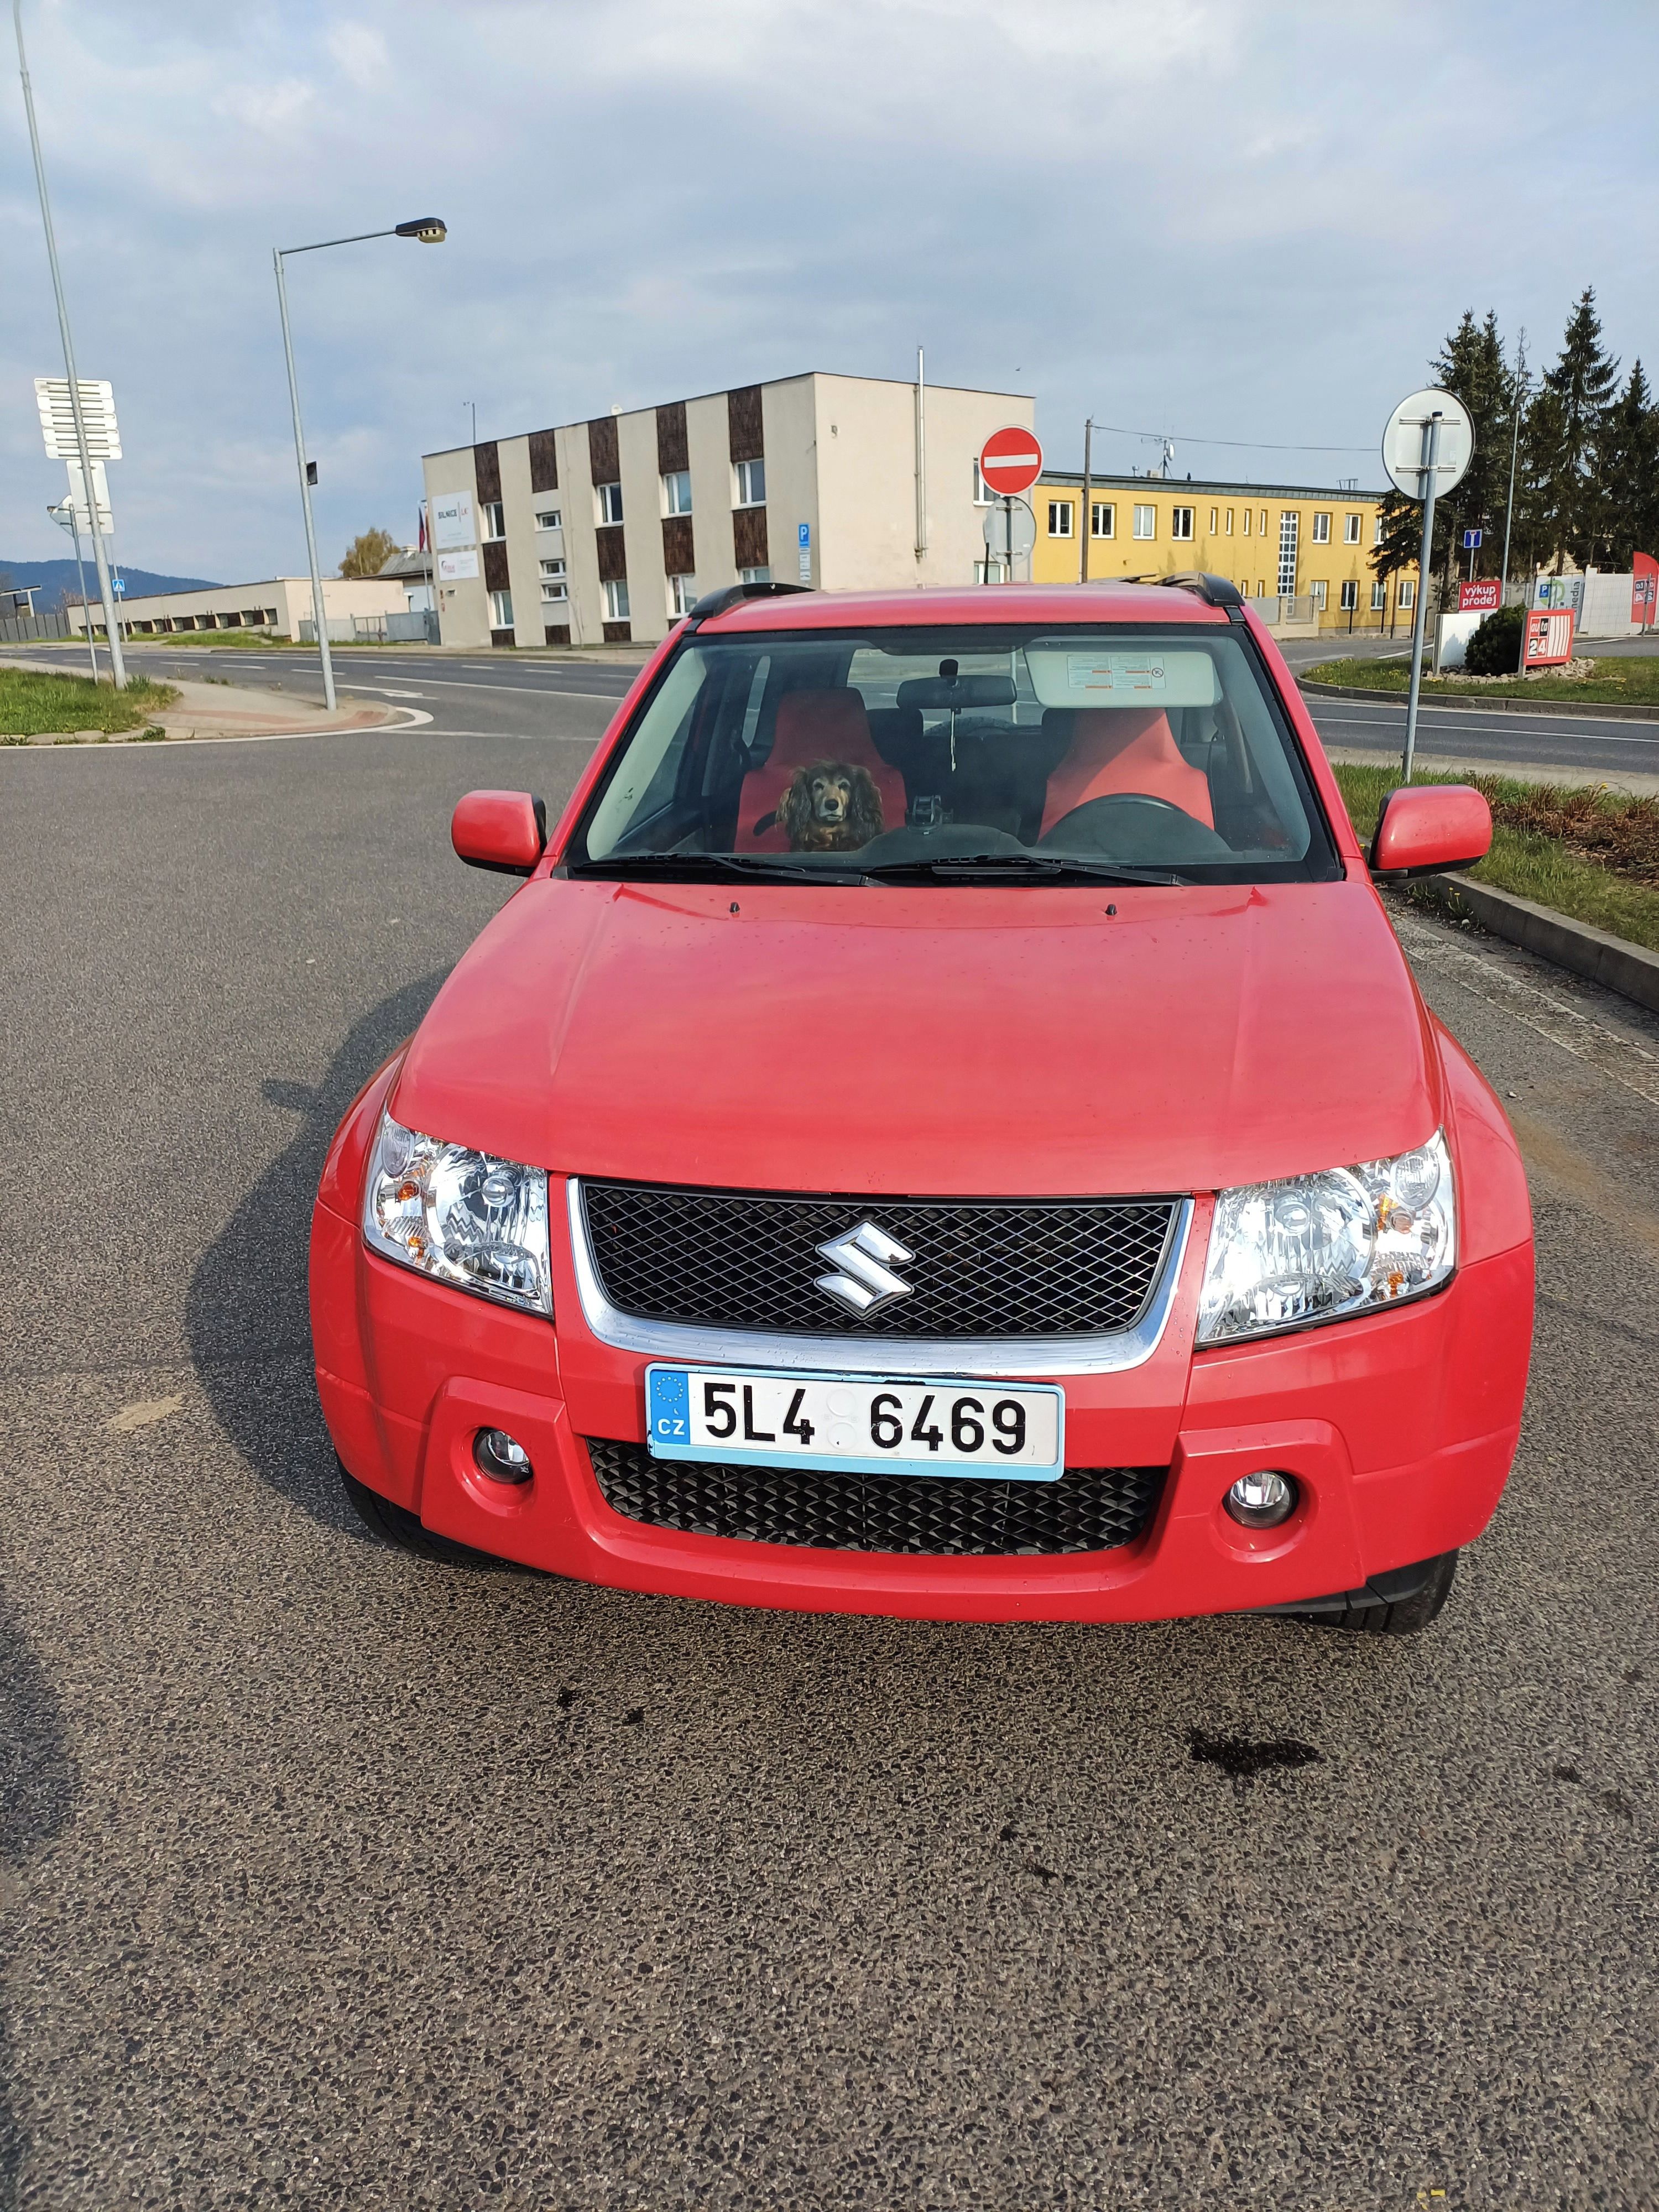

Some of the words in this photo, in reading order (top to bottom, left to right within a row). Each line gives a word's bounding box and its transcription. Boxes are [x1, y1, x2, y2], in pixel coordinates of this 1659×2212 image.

[800, 526, 808, 540] P
[1465, 585, 1496, 597] výkup
[1462, 594, 1496, 608] prodej
[1531, 620, 1548, 633] auta
[1528, 639, 1546, 655] 24
[704, 1383, 815, 1445] 5L4
[870, 1393, 1026, 1455] 6469
[658, 1418, 685, 1436] CZ
